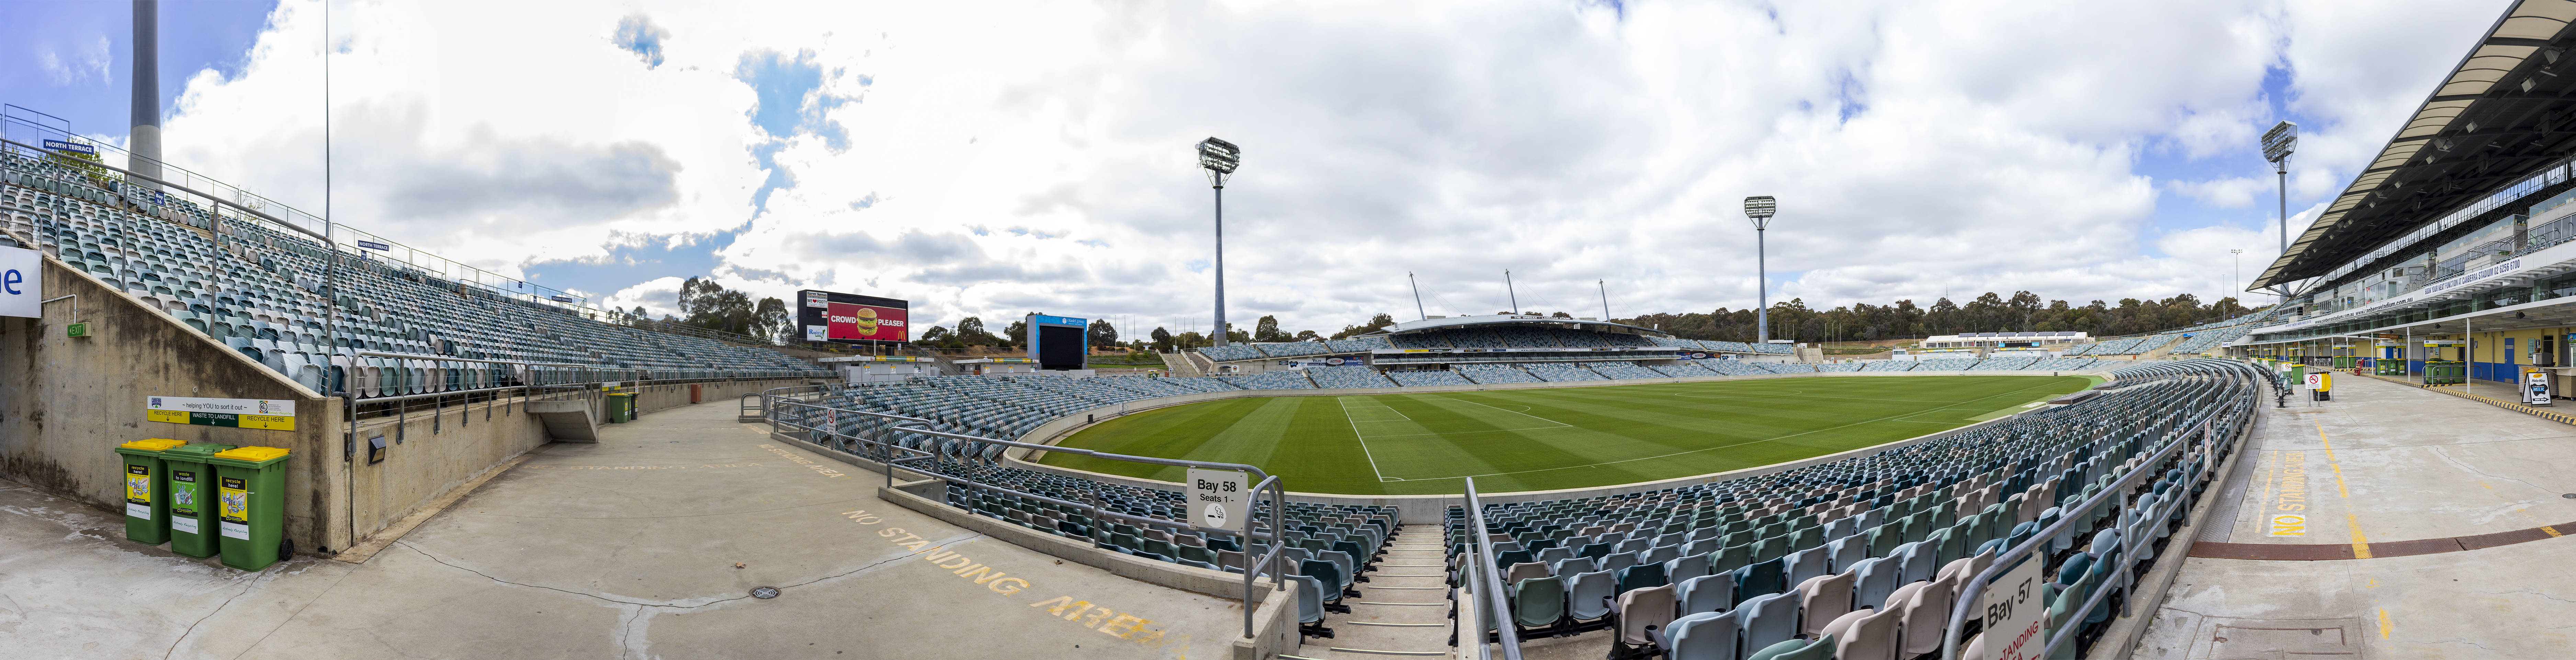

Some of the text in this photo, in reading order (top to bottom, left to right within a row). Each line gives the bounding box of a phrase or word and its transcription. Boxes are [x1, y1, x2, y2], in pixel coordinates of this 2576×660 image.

[68, 144, 92, 152] TERRACE
[0, 269, 23, 295] e
[2445, 280, 2458, 289] FUNCTION
[2462, 274, 2478, 284] CANBERRA
[2478, 268, 2494, 279] STADIUM
[2499, 263, 2509, 273] 6256
[2510, 259, 2520, 271] 6700
[2355, 297, 2413, 315] www.canberrastadium.com.au
[831, 315, 856, 323] CROWD
[2315, 312, 2354, 324] www.canberrastadium.com.au
[72, 326, 82, 334] EXIT
[768, 448, 814, 464] STANDING
[805, 465, 845, 478] AREA
[1198, 479, 1236, 493] Bay 58
[2273, 450, 2305, 535] NO STANDING AREA
[1200, 493, 1221, 502] Seats
[842, 510, 883, 525] NO
[878, 527, 1030, 597] STANDING
[1988, 577, 2032, 630] Bay 57
[1999, 621, 2038, 660] TANDING
